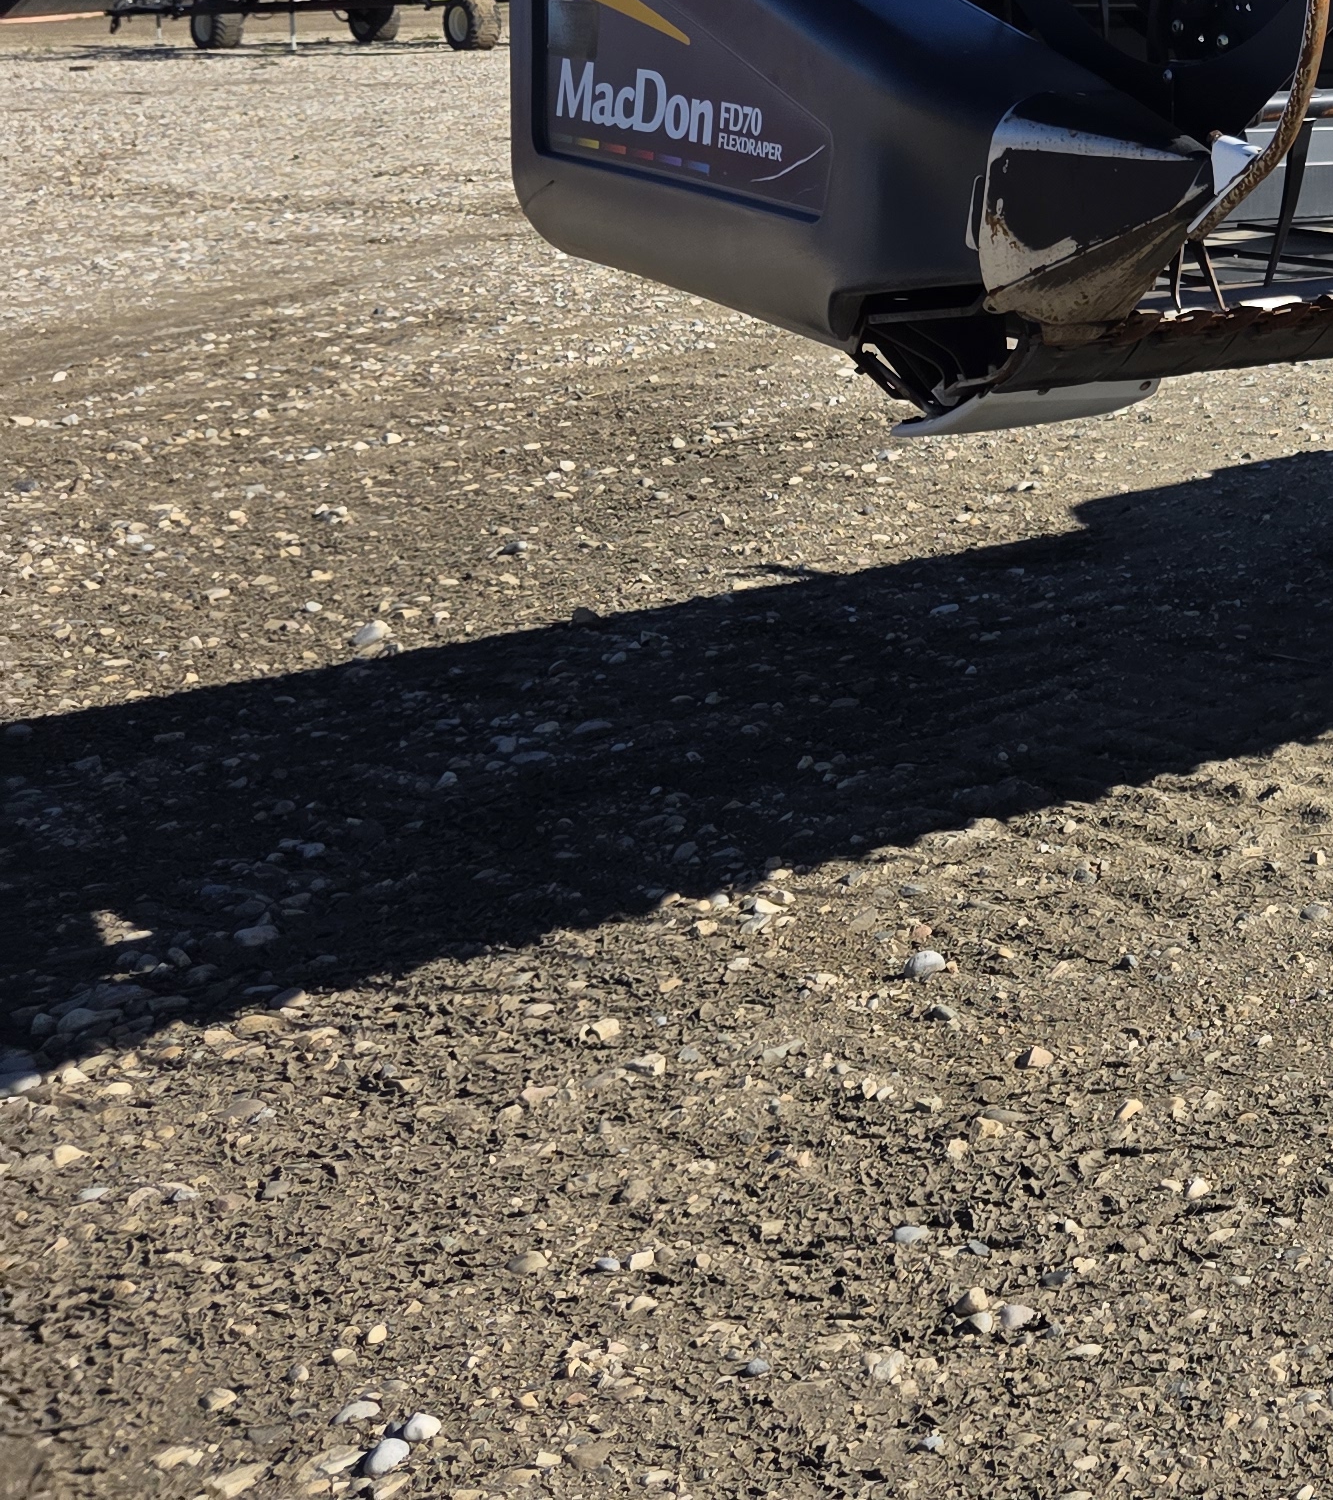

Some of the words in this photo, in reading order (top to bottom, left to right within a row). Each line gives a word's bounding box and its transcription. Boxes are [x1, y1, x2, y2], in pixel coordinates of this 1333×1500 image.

[556, 58, 714, 146] MacDon
[719, 101, 762, 136] FD70
[718, 132, 782, 162] FLEXDRAPER
